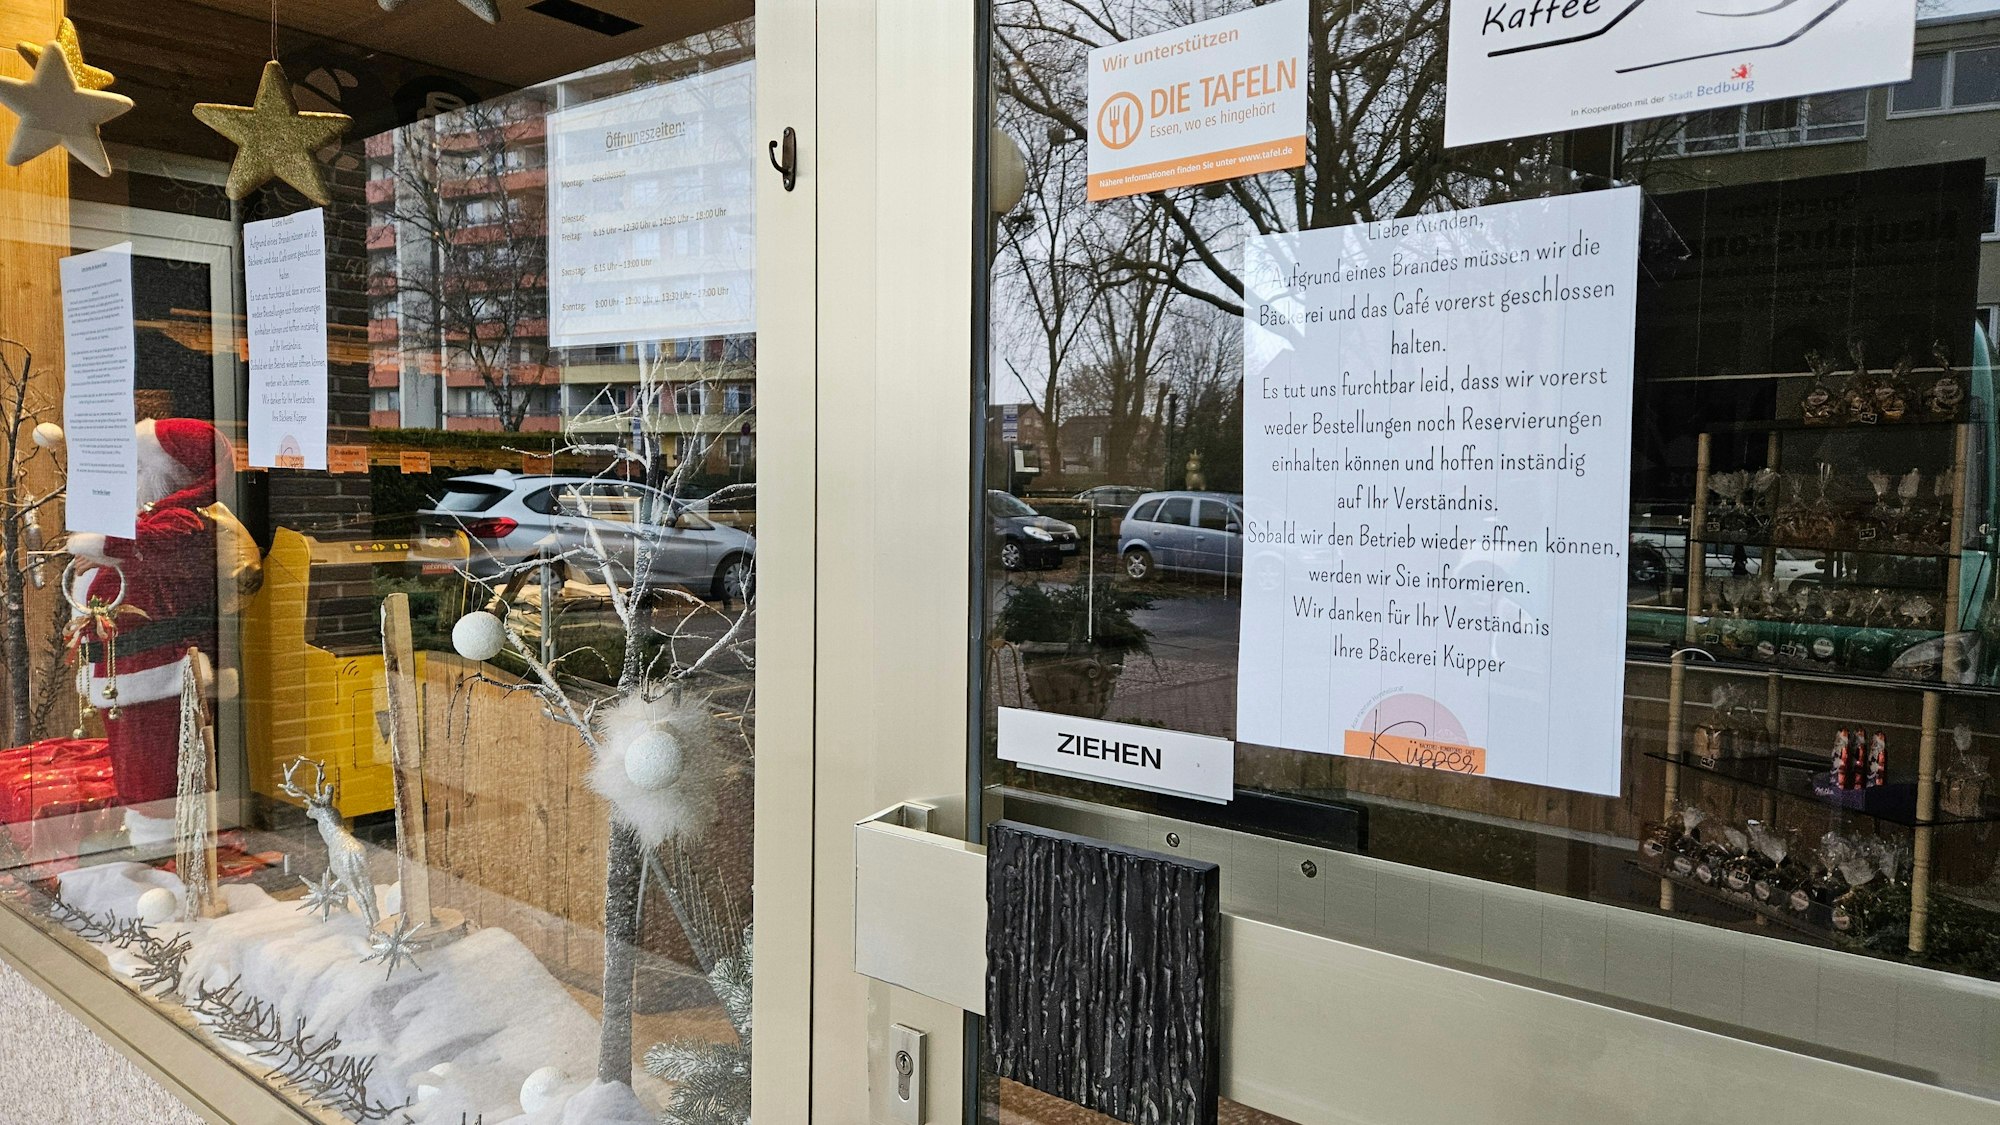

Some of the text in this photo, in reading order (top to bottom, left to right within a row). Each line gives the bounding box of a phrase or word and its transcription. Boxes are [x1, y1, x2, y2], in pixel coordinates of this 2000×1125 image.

[1482, 0, 1601, 35] Kaffee
[1102, 28, 1239, 72] Wir unterstützen
[1150, 57, 1297, 119] DIE TAFELN
[1571, 80, 1755, 117] In Kooperation mit der Stadt Bedburg
[606, 121, 686, 149] Öffnungszeiten:
[1150, 101, 1276, 138] Essen, wo es hingehört
[1099, 146, 1293, 188] Nähere Informationen finden Sie unter www.tafel.de
[606, 225, 618, 235] Uhr
[714, 207, 727, 217] Uhr
[1368, 220, 1409, 240] Liebe
[1272, 229, 1600, 291] Aufgrund eines Brandes müssen wir die
[1260, 274, 1615, 326] Bäckerei und das Café vorerst geschlossen
[1392, 328, 1446, 354] halten.
[1263, 364, 1608, 399] Es tut uns furchtbar leid, dass wir vorerst
[1264, 405, 1602, 439] weder Bestellungen noch Reservierungen
[1272, 443, 1586, 477] einhalten können und hoffen inständig
[1337, 484, 1498, 511] auf Ihr Verständnis.
[1248, 520, 1620, 557] Sobald wir den Betrieb wieder öffnen können,
[1309, 560, 1530, 594] werden wir Sie informieren.
[1293, 595, 1550, 636] Wir danken für Ihr Verständnis
[1334, 633, 1506, 677] Ihre Bäckerei Küpper
[1056, 732, 1162, 770] ZIEHEN
